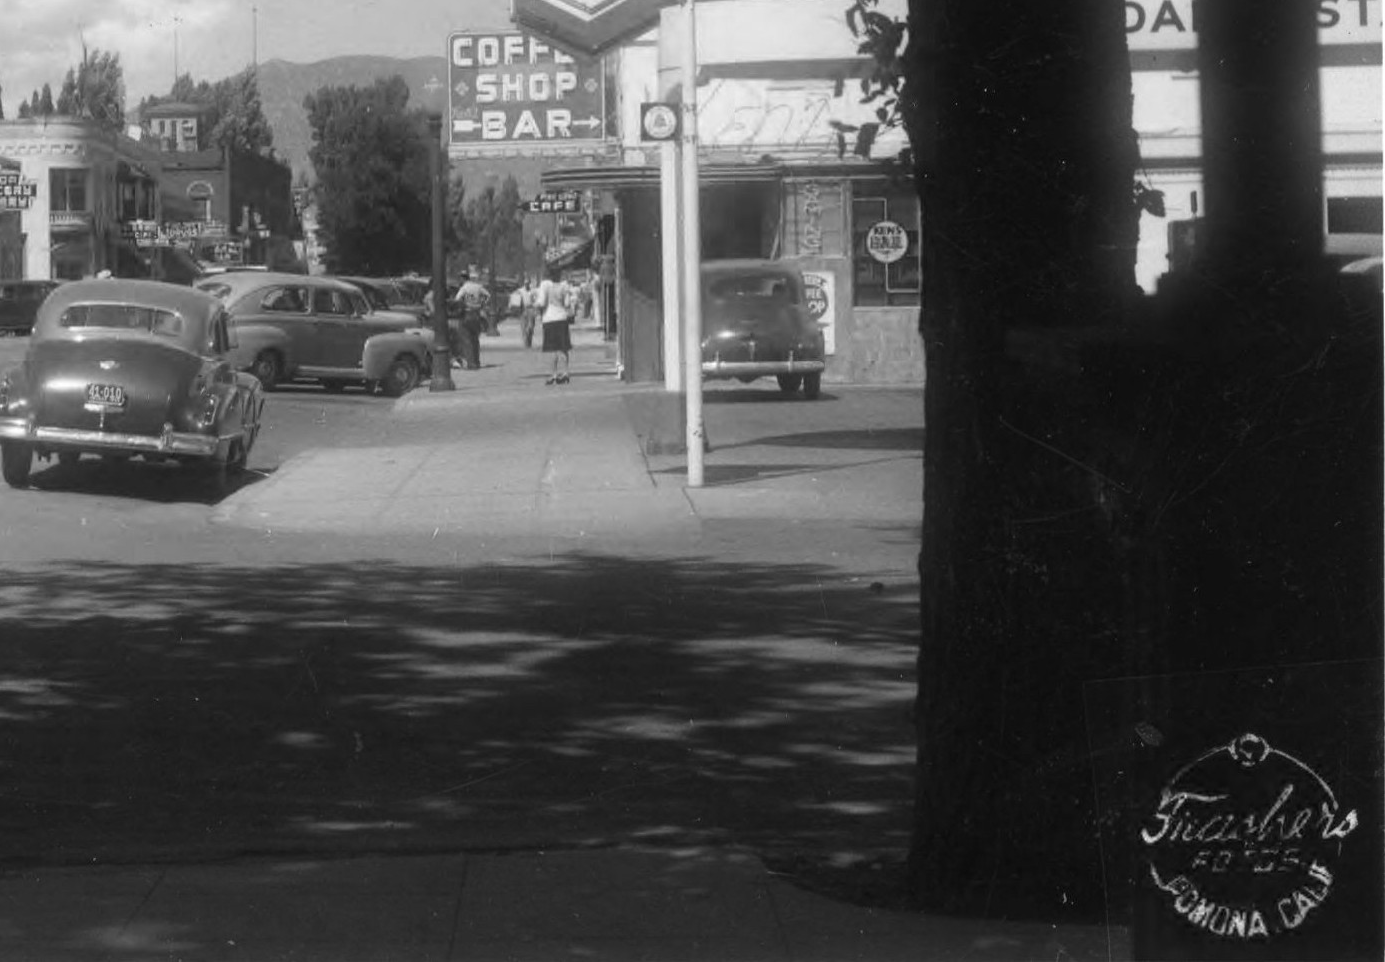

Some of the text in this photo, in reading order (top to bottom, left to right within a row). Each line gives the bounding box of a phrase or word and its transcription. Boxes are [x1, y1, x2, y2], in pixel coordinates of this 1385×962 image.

[476, 71, 577, 104] SHOP
[482, 110, 571, 139] BAR
[530, 201, 576, 212] CAFE
